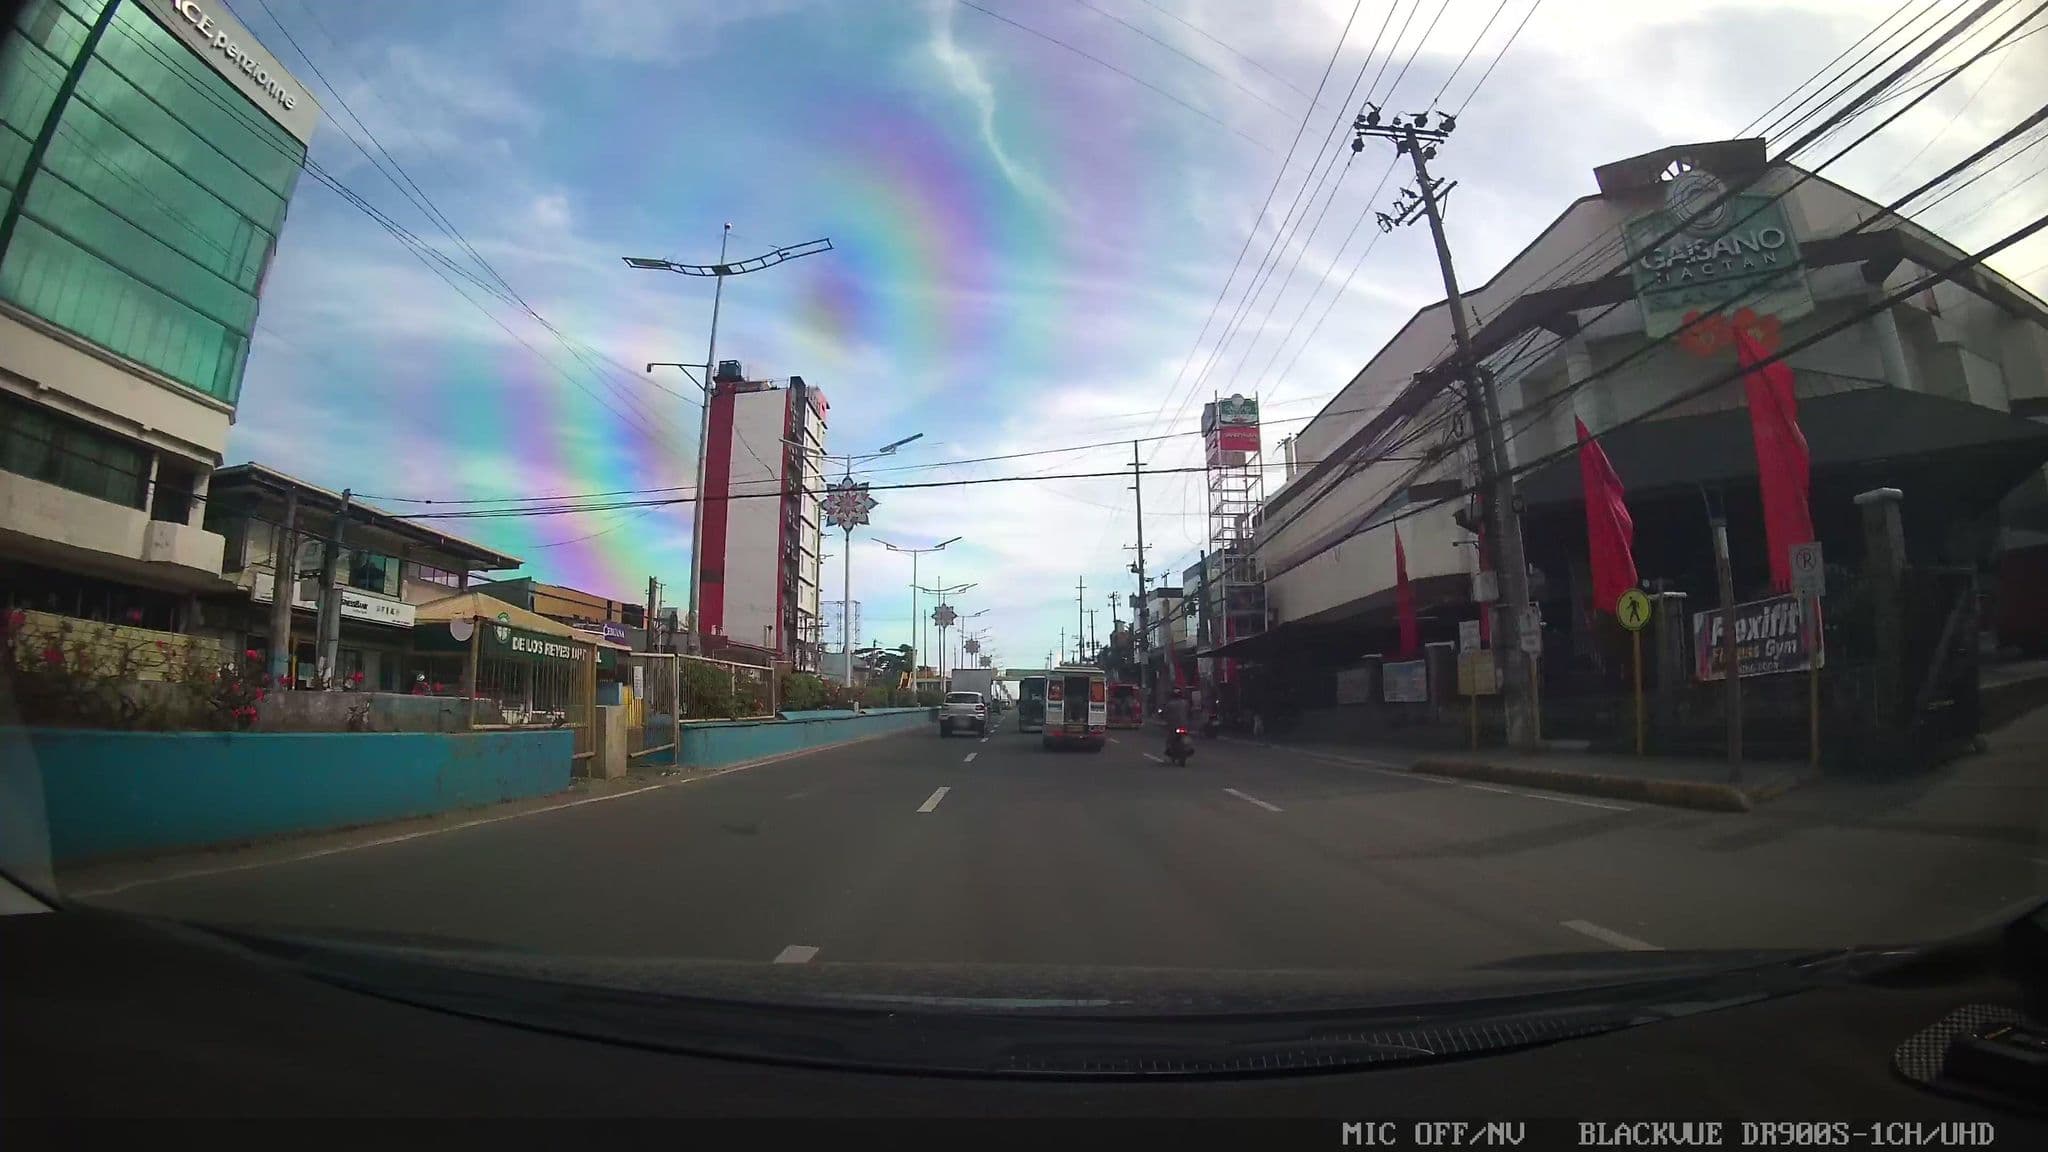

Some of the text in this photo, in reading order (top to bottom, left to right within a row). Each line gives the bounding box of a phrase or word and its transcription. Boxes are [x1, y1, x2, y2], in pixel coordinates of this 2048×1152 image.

[171, 0, 297, 111] CE penzionne
[1712, 602, 1799, 646] Fexifit
[512, 636, 526, 652] DE
[526, 640, 544, 655] LOS
[544, 643, 571, 660] REYES
